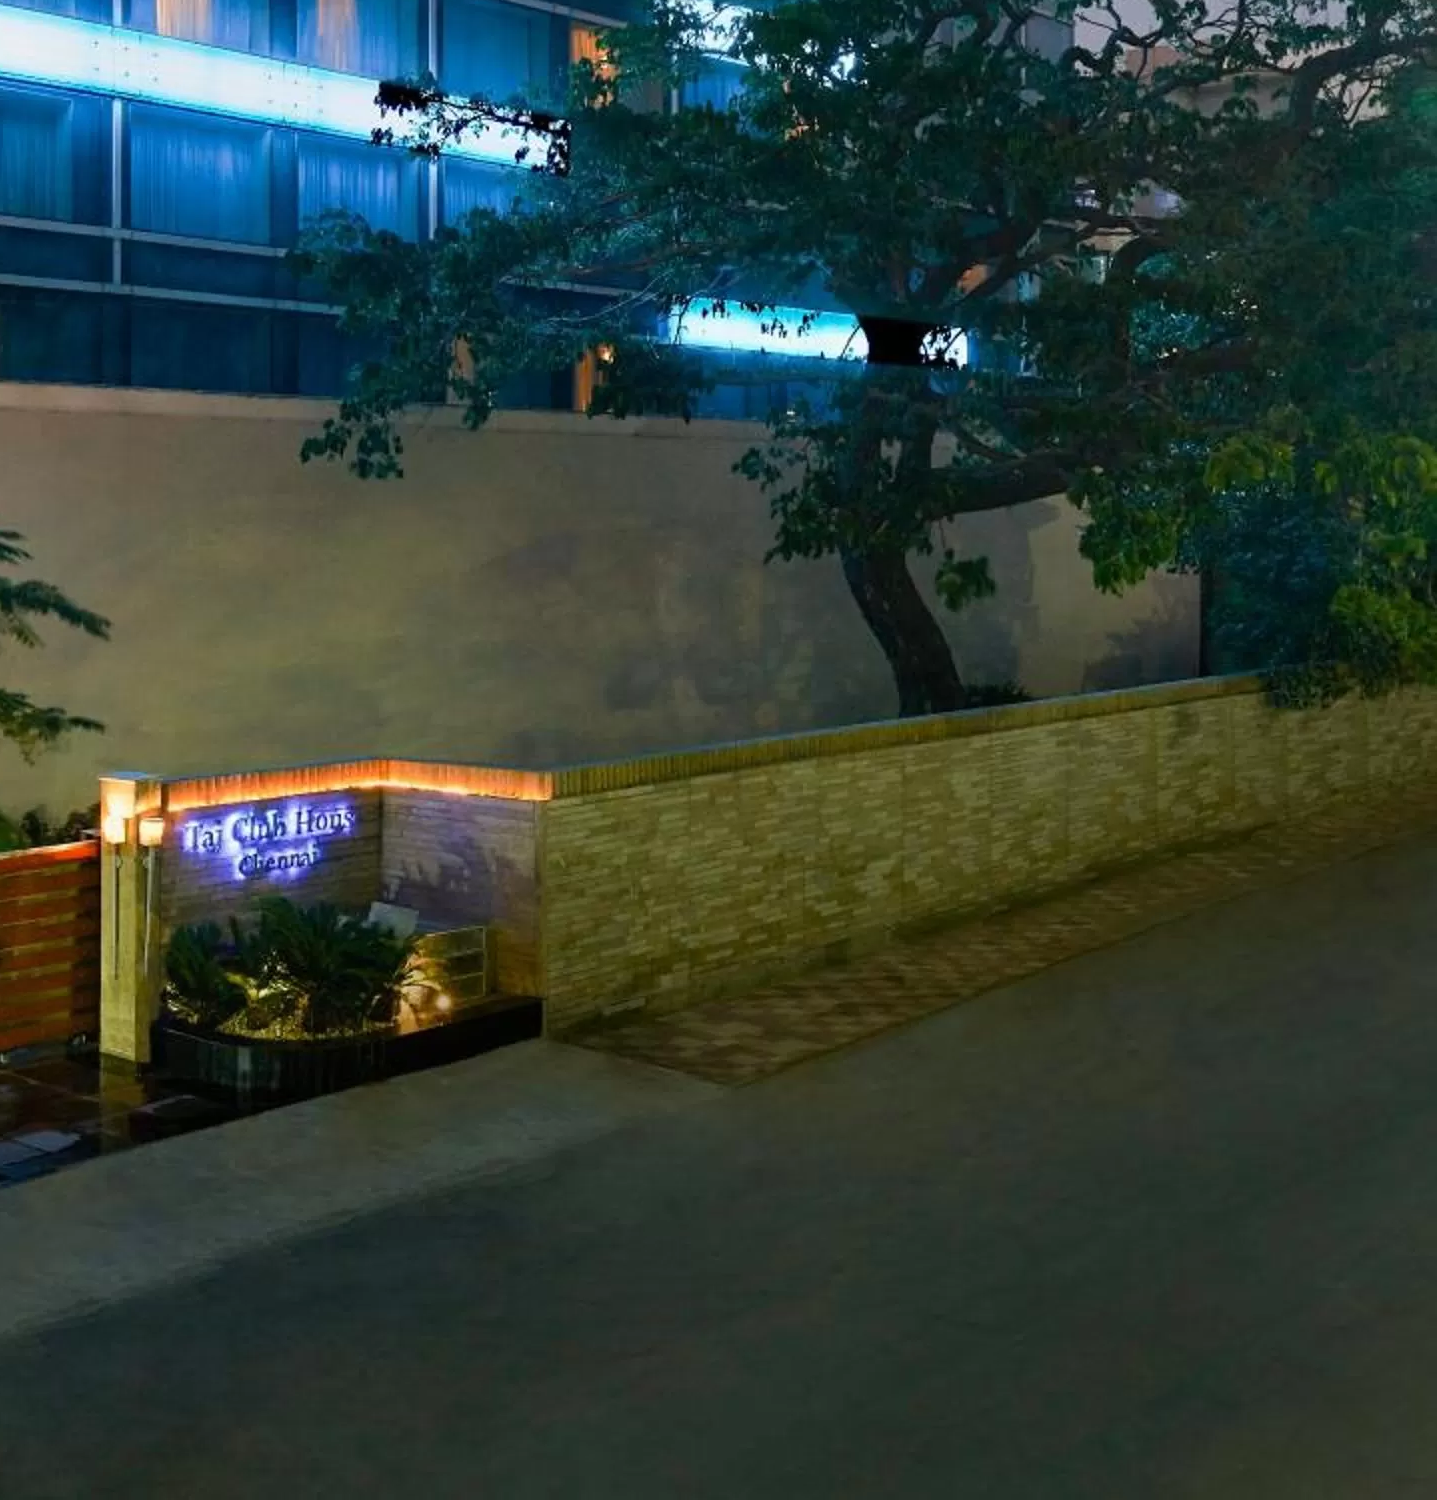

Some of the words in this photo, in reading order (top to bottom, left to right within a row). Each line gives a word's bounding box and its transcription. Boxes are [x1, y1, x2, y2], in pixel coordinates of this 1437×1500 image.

[184, 819, 223, 853] Taj
[232, 811, 287, 843] Club
[238, 841, 321, 877] Chennai
